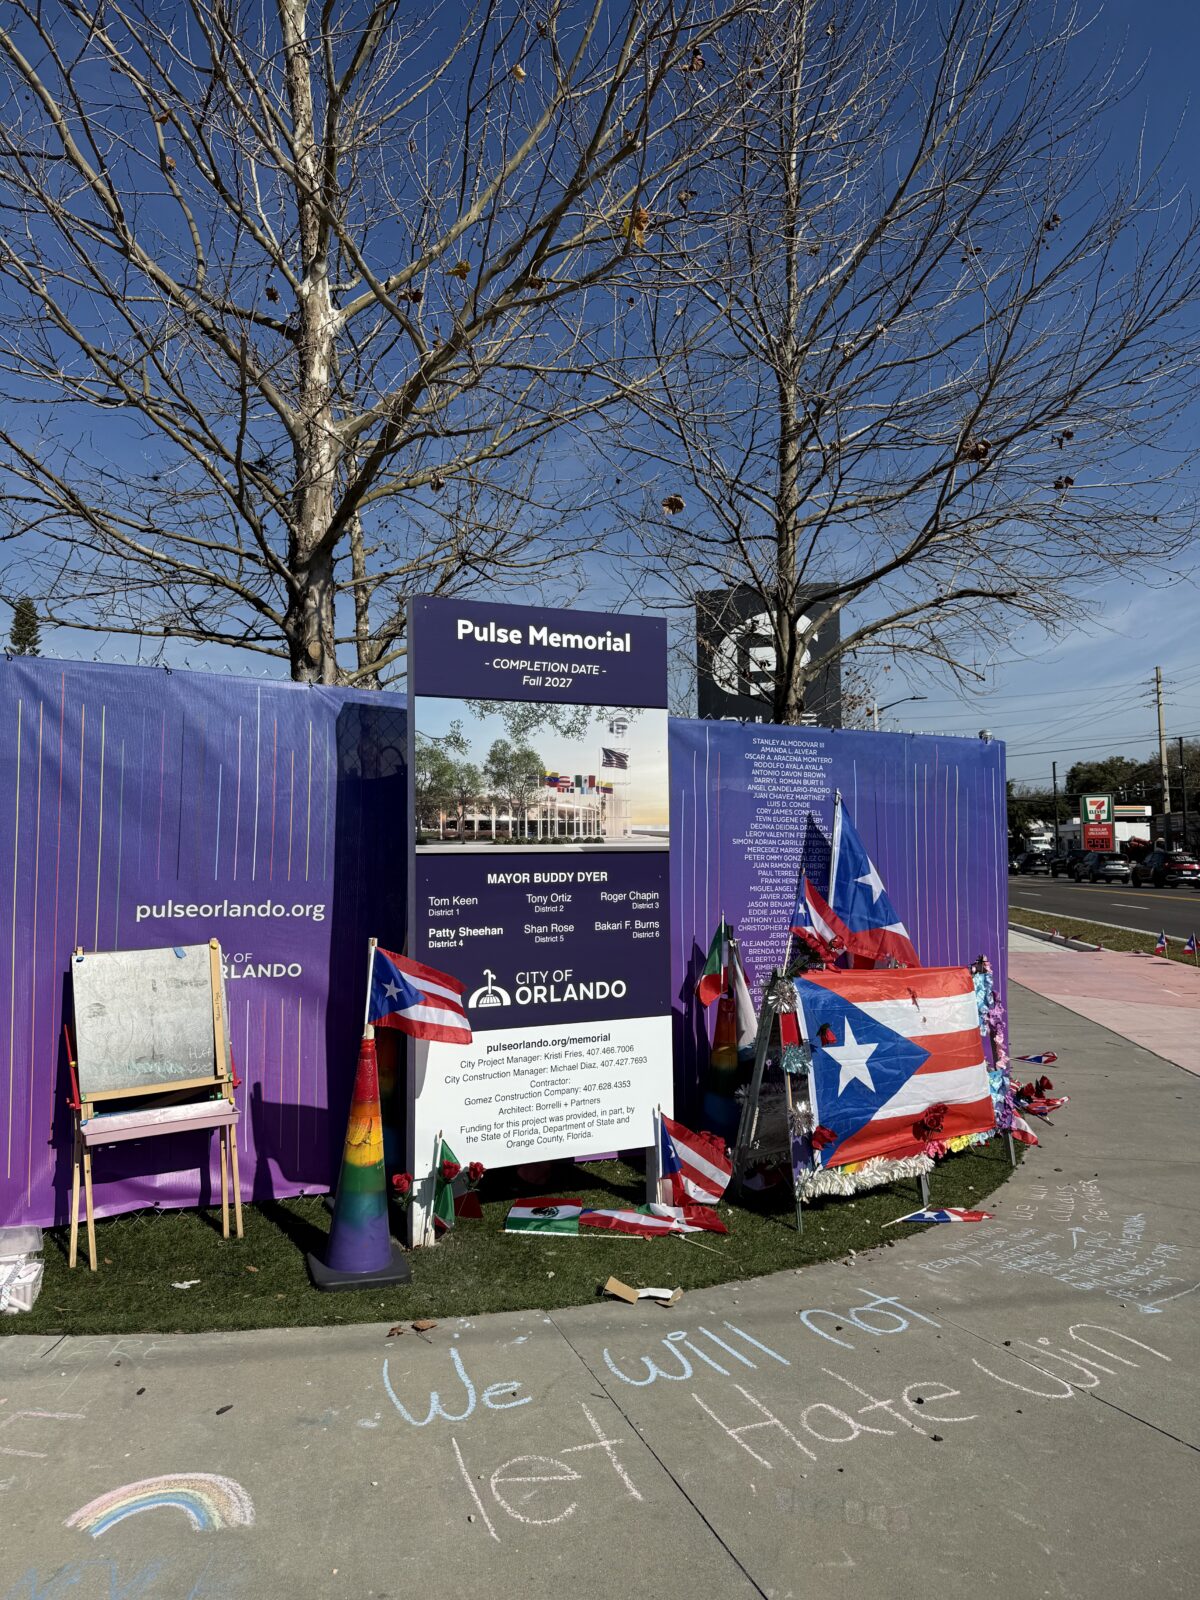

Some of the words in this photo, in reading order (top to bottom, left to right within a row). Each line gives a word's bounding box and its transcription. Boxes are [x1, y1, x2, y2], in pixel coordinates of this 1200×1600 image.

[457, 619, 522, 644] Pulse
[529, 625, 631, 653] Memorial
[493, 659, 568, 673] COMPLETION
[571, 663, 599, 675] DATE
[523, 676, 541, 687] Fall
[545, 677, 572, 688] 2027
[753, 738, 779, 746] STANLEY
[781, 740, 818, 748] ALMODOVAR
[803, 756, 832, 764] MONTERO
[768, 785, 830, 794] CANDELARIO-PADRO
[1089, 800, 1105, 820] 7
[777, 839, 808, 847] CARRILLO
[487, 873, 530, 884] MAYOR
[534, 872, 574, 883] BUDDY
[577, 872, 608, 882] DYER
[429, 897, 449, 906] Tom
[452, 896, 478, 905] Keen
[526, 894, 548, 904] Tony
[551, 893, 572, 903] Ortiz
[601, 892, 627, 902] Roger
[629, 891, 659, 902] Chapin
[136, 900, 325, 922] pulseorlando.org
[534, 905, 557, 913] District
[632, 902, 653, 910] District
[524, 924, 548, 934] Shan
[551, 924, 574, 933] Rose
[595, 922, 621, 931] Bakari
[635, 920, 659, 929] Burns
[429, 928, 456, 939] Patty
[459, 926, 503, 937] Sheehan
[633, 931, 653, 939] District
[535, 935, 557, 943] District
[234, 953, 253, 963] OF
[516, 970, 549, 985] CITY
[553, 969, 573, 982] OF
[516, 980, 626, 1005] ORLANDO
[486, 1033, 611, 1054] pulseorlando.org/memorial
[460, 1060, 475, 1070] City
[478, 1056, 504, 1068] Project
[507, 1053, 543, 1065] Manager:
[544, 1051, 562, 1060] Kristi
[564, 1049, 585, 1059] Fries,
[445, 1075, 460, 1085] City
[463, 1070, 511, 1083] Construction
[513, 1066, 548, 1078] Manager:
[550, 1063, 578, 1072] Michael
[580, 1061, 599, 1070] Diaz,
[600, 1056, 648, 1068] 407.427.7693
[530, 1077, 571, 1088] Contractor:
[464, 1095, 492, 1106] Gomez
[495, 1090, 542, 1102] Construction
[583, 1080, 631, 1091] 407.628.4353
[498, 1105, 534, 1115] Architect:
[536, 1100, 562, 1111] Borrelli
[571, 1097, 600, 1107] Partners
[460, 1123, 491, 1134] Funding
[494, 1121, 504, 1130] for
[506, 1120, 520, 1129] this
[522, 1116, 547, 1128] project
[565, 1111, 599, 1123] provided,
[609, 1107, 624, 1118] part,
[626, 1106, 635, 1116] by
[466, 1134, 479, 1143] the
[481, 1132, 502, 1142] State
[503, 1130, 511, 1139] of
[513, 1126, 541, 1138] Florida,
[543, 1122, 585, 1134] Department
[587, 1121, 594, 1129] of
[596, 1117, 615, 1127] State
[617, 1116, 630, 1125] and
[507, 1137, 535, 1149] Orange
[537, 1134, 564, 1146] County,
[566, 1130, 593, 1141] Florida.
[383, 1346, 533, 1428] We
[604, 1321, 790, 1386] will
[800, 1288, 941, 1350] not
[451, 1401, 643, 1542] let
[692, 1368, 978, 1469] Hate
